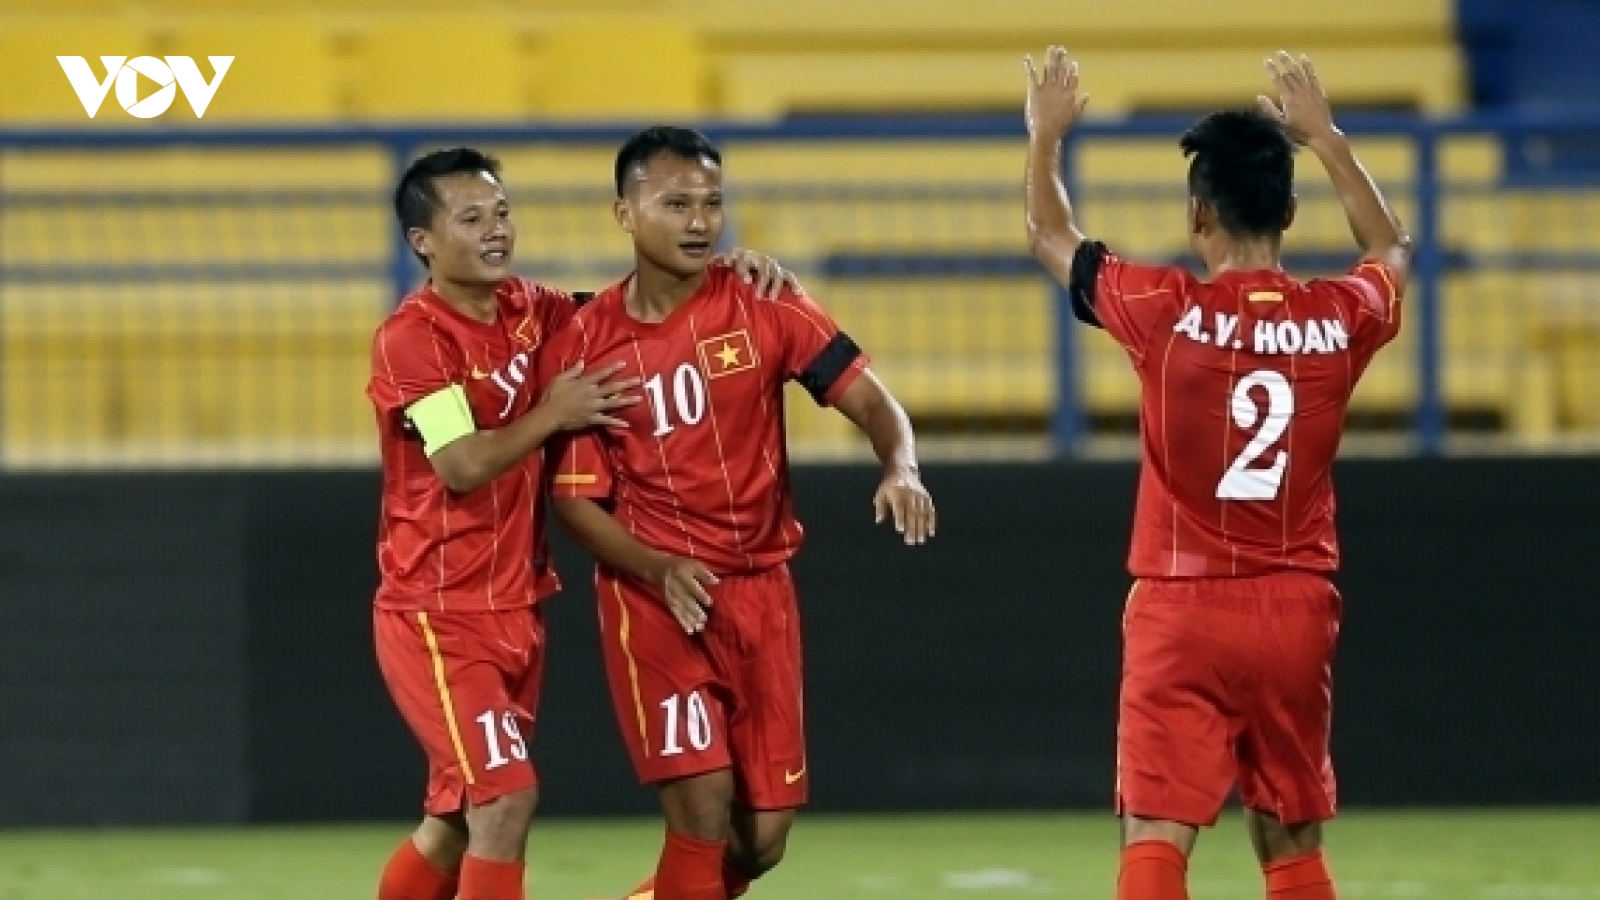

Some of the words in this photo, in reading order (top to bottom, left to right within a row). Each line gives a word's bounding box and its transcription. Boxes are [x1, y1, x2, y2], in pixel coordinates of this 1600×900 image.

[1173, 305, 1244, 348] A.V.
[1254, 319, 1349, 354] HOAN
[644, 362, 705, 436] 10
[1215, 369, 1294, 500] 2
[475, 709, 529, 770] 19
[659, 690, 711, 756] 10
